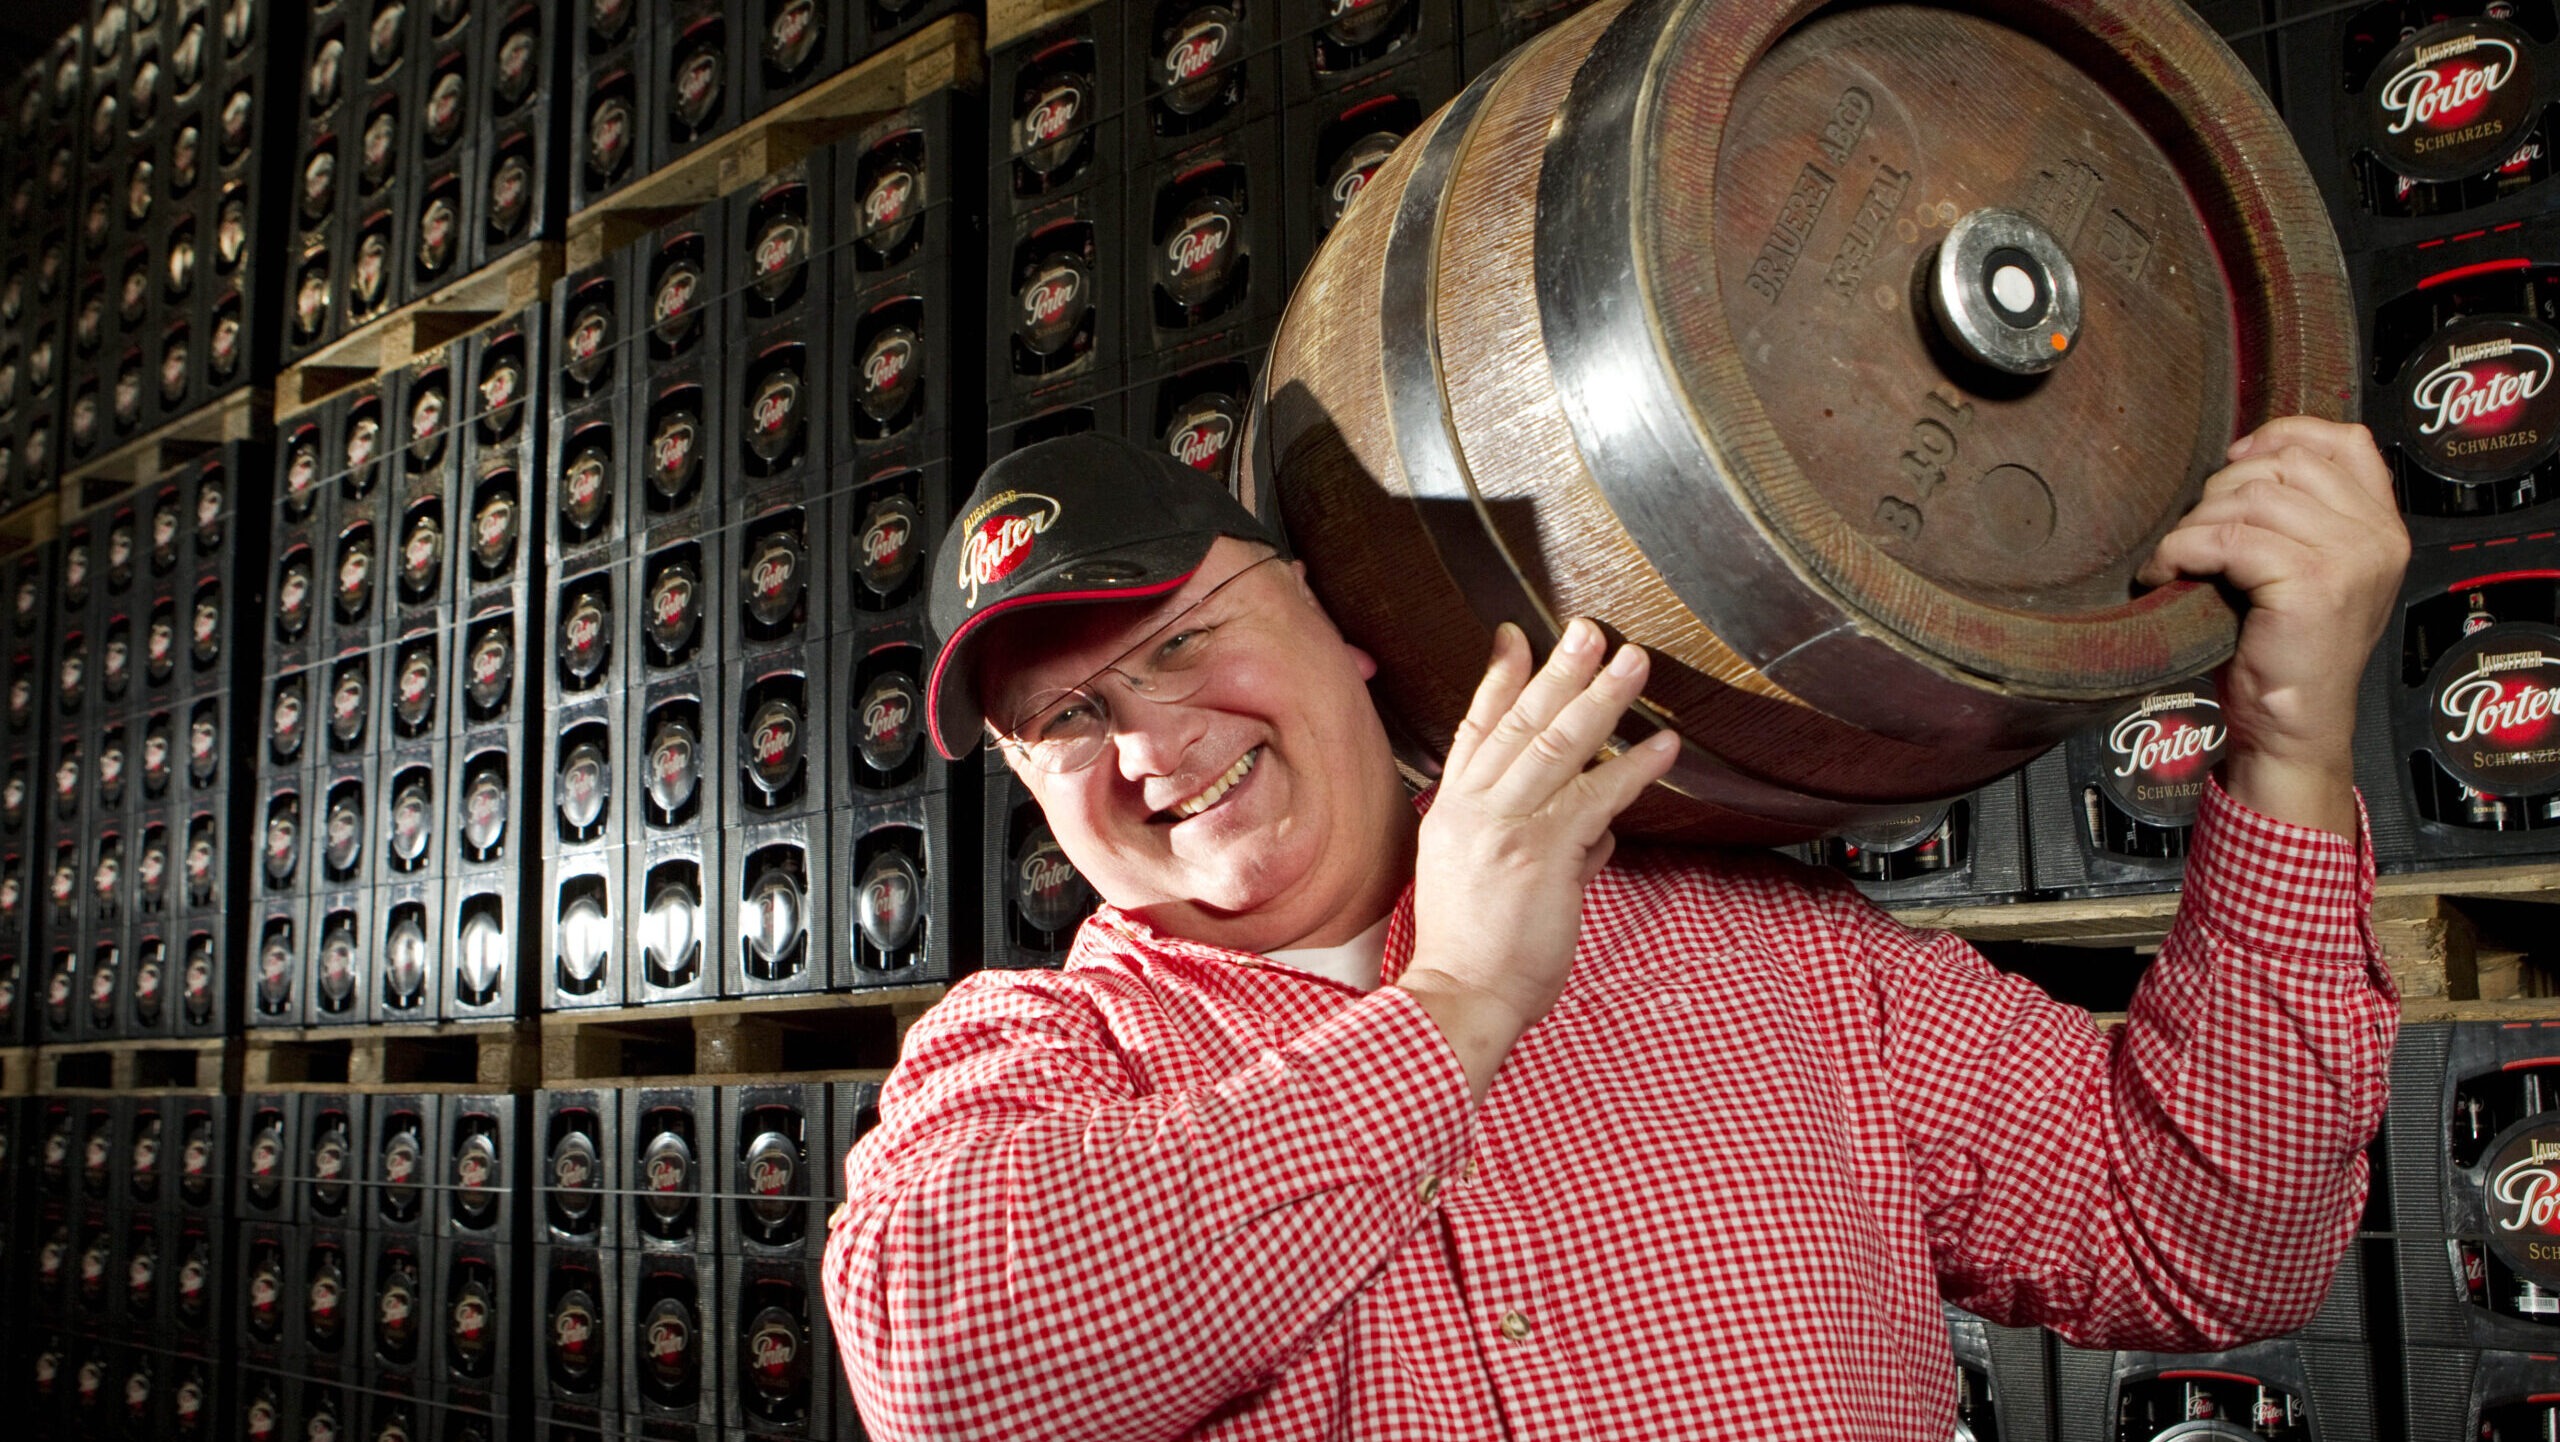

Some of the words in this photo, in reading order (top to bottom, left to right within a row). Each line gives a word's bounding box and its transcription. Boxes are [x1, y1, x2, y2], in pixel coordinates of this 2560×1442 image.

[1166, 32, 1226, 85] Porter
[2381, 60, 2515, 134] Porter
[2414, 119, 2503, 153] SCHWARZES
[1170, 222, 1229, 276] Porter
[1745, 162, 1836, 303] BRAUEREI
[1825, 161, 1912, 298] KREUZTAL
[1025, 276, 1078, 325] Porter
[2414, 362, 2549, 434] Porter
[1171, 422, 1231, 465] Porter
[2447, 429, 2538, 458] SCHWARZES
[959, 508, 1052, 609] Porter
[2109, 717, 2227, 777] Porter
[2137, 782, 2204, 801] SCHWARZ
[1022, 857, 1076, 896] Porter
